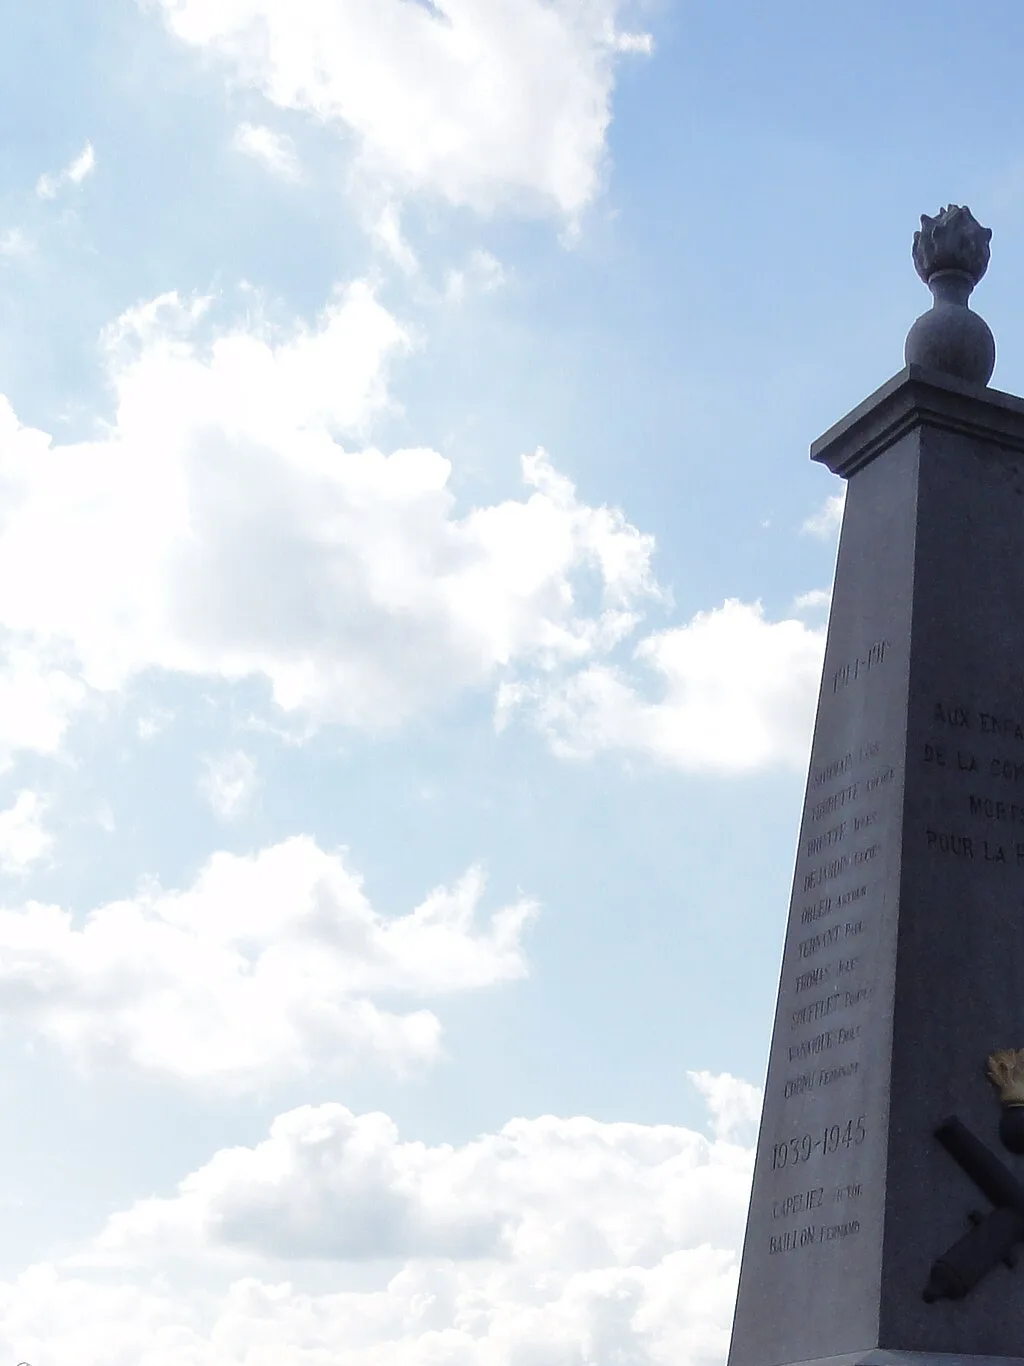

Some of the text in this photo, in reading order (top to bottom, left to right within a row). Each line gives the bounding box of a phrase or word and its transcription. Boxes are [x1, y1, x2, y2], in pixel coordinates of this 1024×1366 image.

[934, 702, 969, 729] AUX
[924, 744, 946, 766] DE
[957, 751, 977, 772] LA
[926, 830, 974, 859] POUR
[983, 840, 1005, 863] LA
[771, 1116, 867, 1171] 1939-1945
